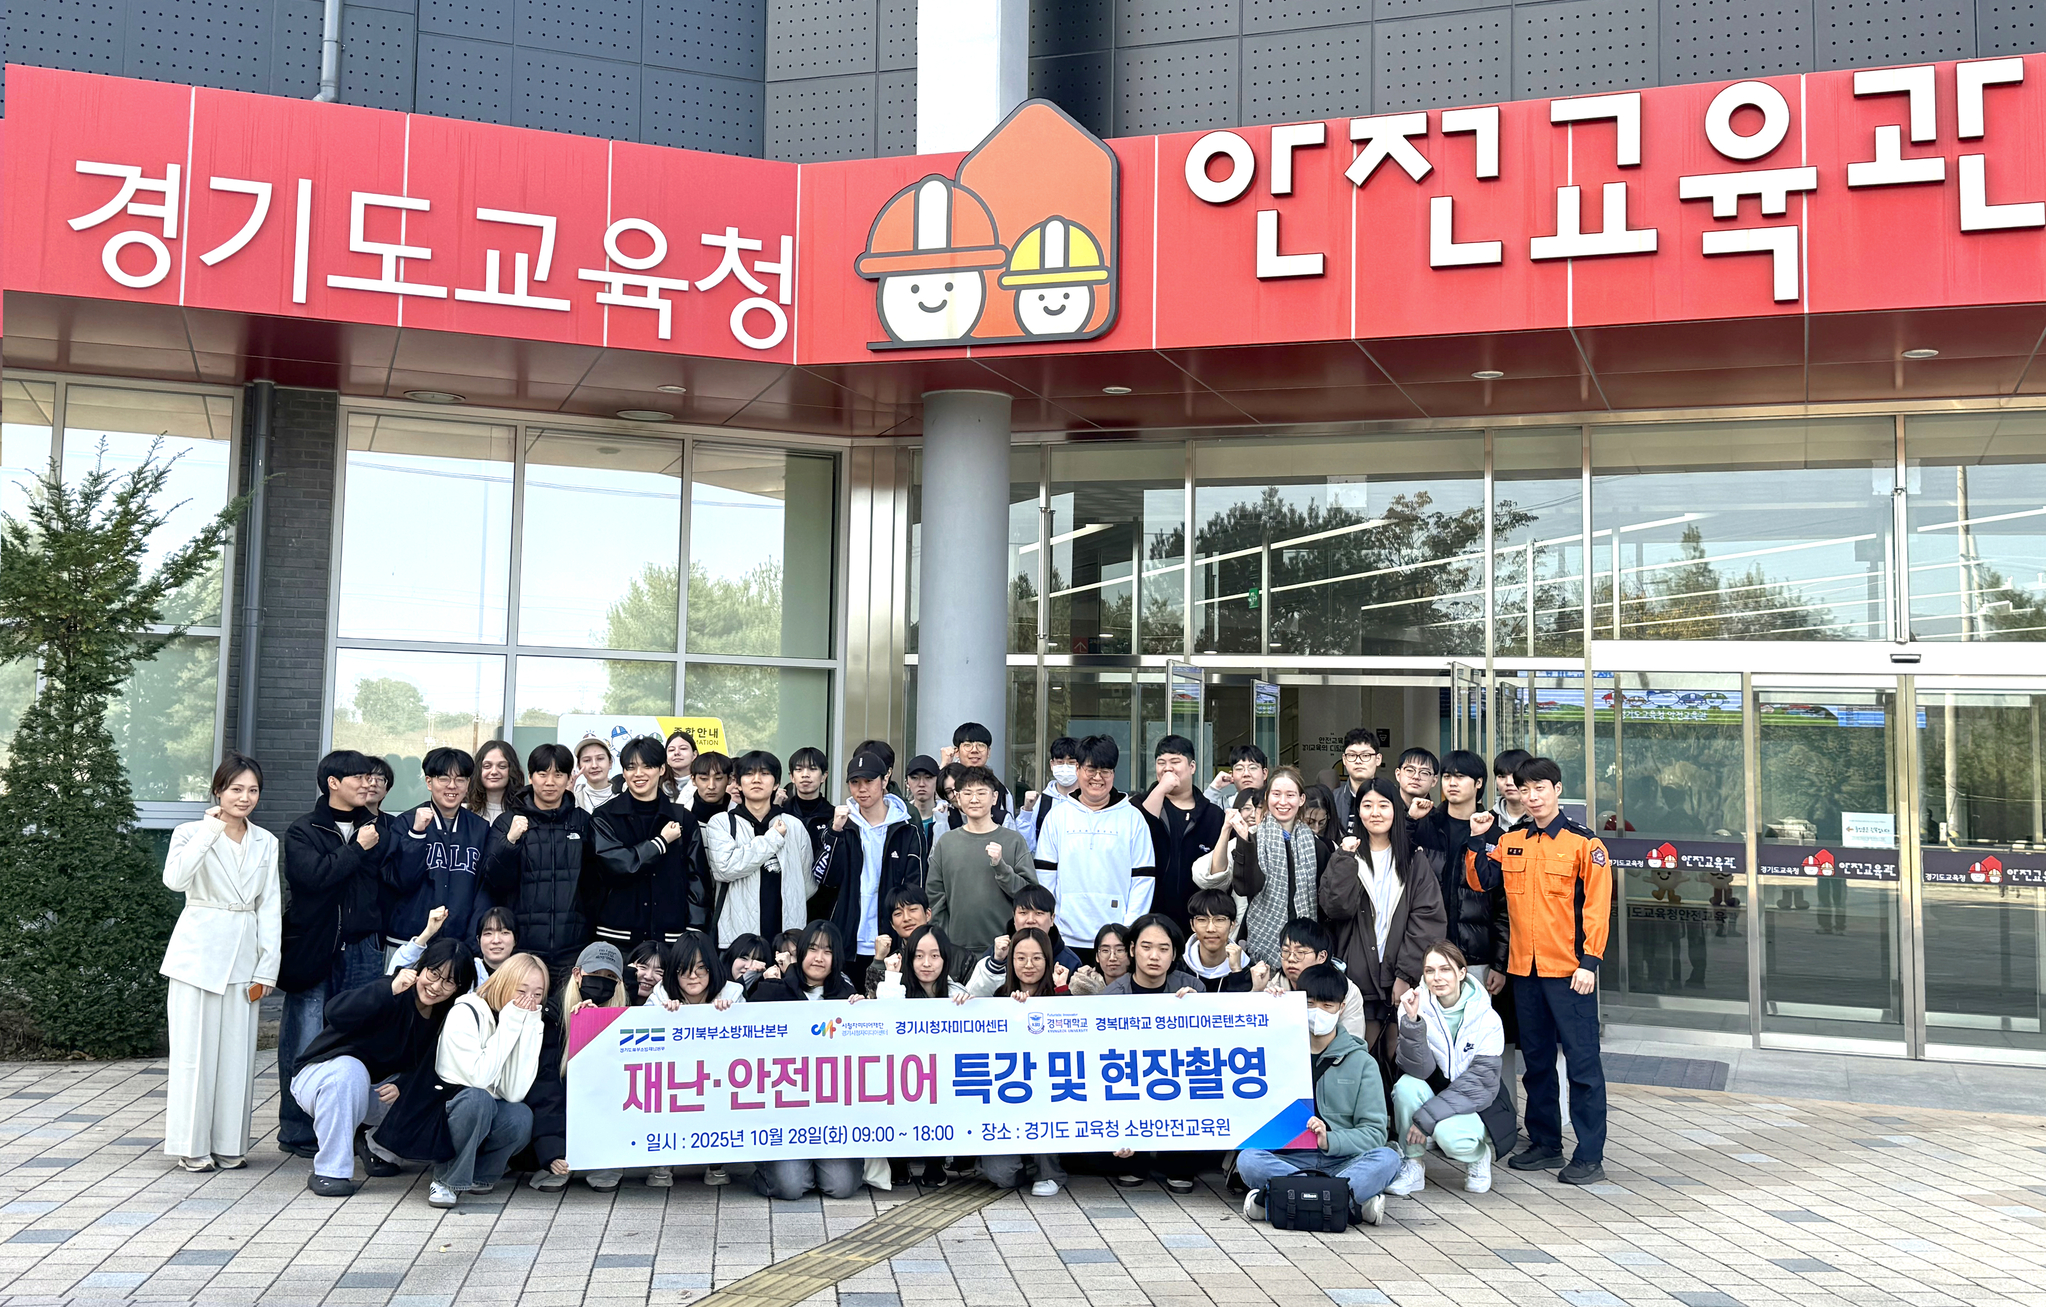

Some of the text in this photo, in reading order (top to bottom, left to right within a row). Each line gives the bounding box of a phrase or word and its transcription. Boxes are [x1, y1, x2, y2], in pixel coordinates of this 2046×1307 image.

[1184, 56, 2046, 302] 안전교육관
[67, 159, 793, 349] 경기도교육청
[1681, 855, 1737, 872] 안전교육관
[1760, 865, 1800, 875] 경기도교육청
[1838, 861, 1897, 880] 안전교육관
[1925, 873, 1966, 883] 경기도교육청
[895, 1019, 1008, 1035] 경기시청자미디어센터
[1047, 1018, 1088, 1029] 경북대학교
[1096, 1013, 1270, 1032] 경북대학교 영상미디어콘텐츠학과
[671, 1023, 789, 1042] 경기북부소방재난본부
[622, 1046, 1269, 1114] 재난·안전미디어 특강 및 현장촬영
[646, 1132, 677, 1152] 일시
[690, 1129, 745, 1149] 2025년
[750, 1127, 783, 1147] 10월
[788, 1125, 848, 1145] 28일(화)
[852, 1126, 895, 1143] 09:00
[912, 1125, 954, 1141] 18:00
[981, 1122, 1012, 1141] 장소
[1024, 1121, 1070, 1140] 경기도
[1074, 1119, 1120, 1138] 교육청
[1124, 1118, 1231, 1138] 소방안전교육원
